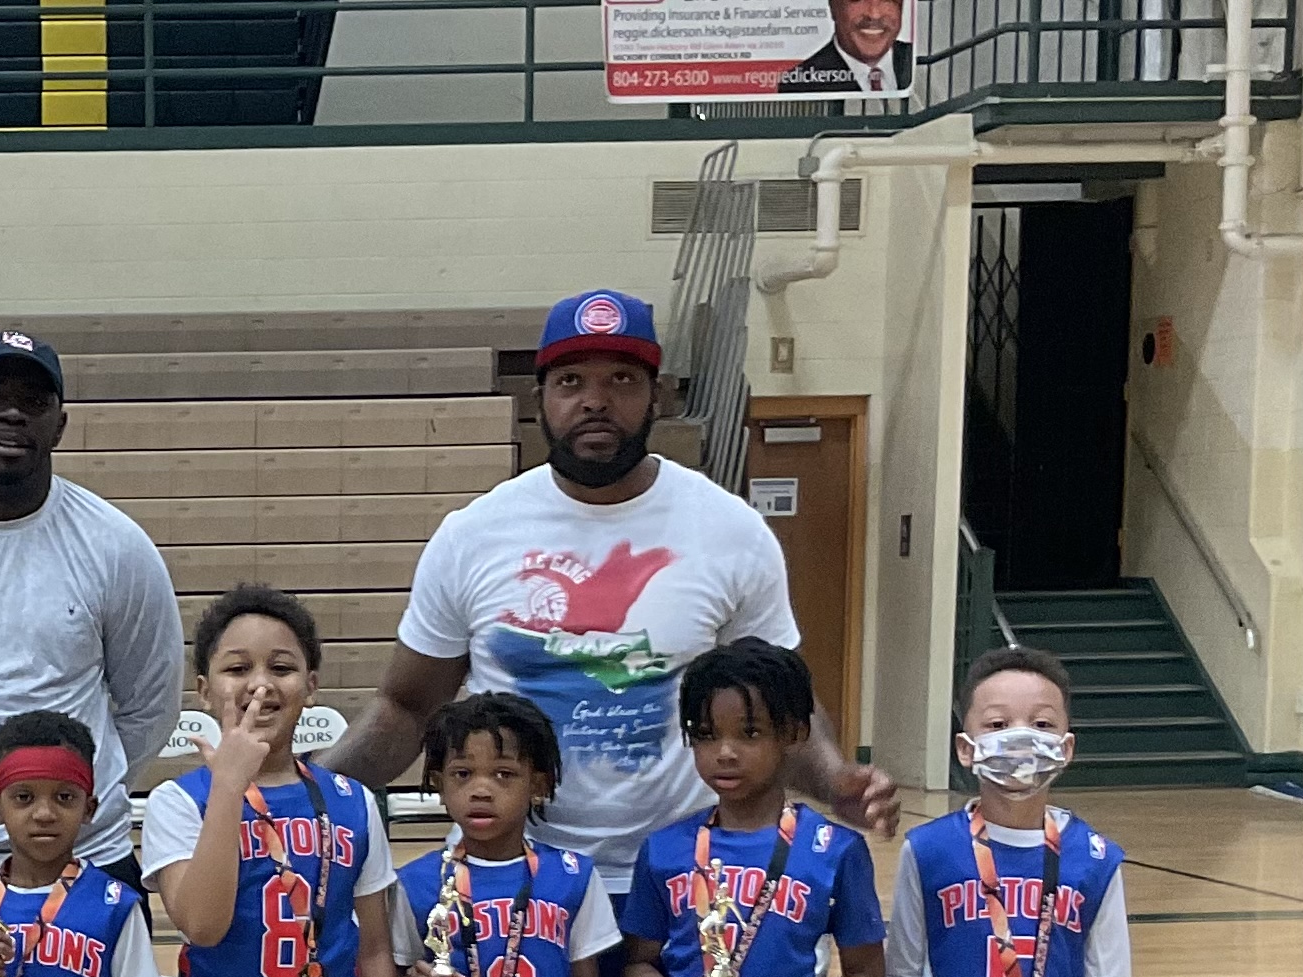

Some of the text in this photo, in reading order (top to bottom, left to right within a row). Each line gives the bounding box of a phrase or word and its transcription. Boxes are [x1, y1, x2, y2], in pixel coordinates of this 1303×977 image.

[613, 6, 827, 24] Providing Insurance & Financial Services
[612, 70, 709, 87] 804-273-6300
